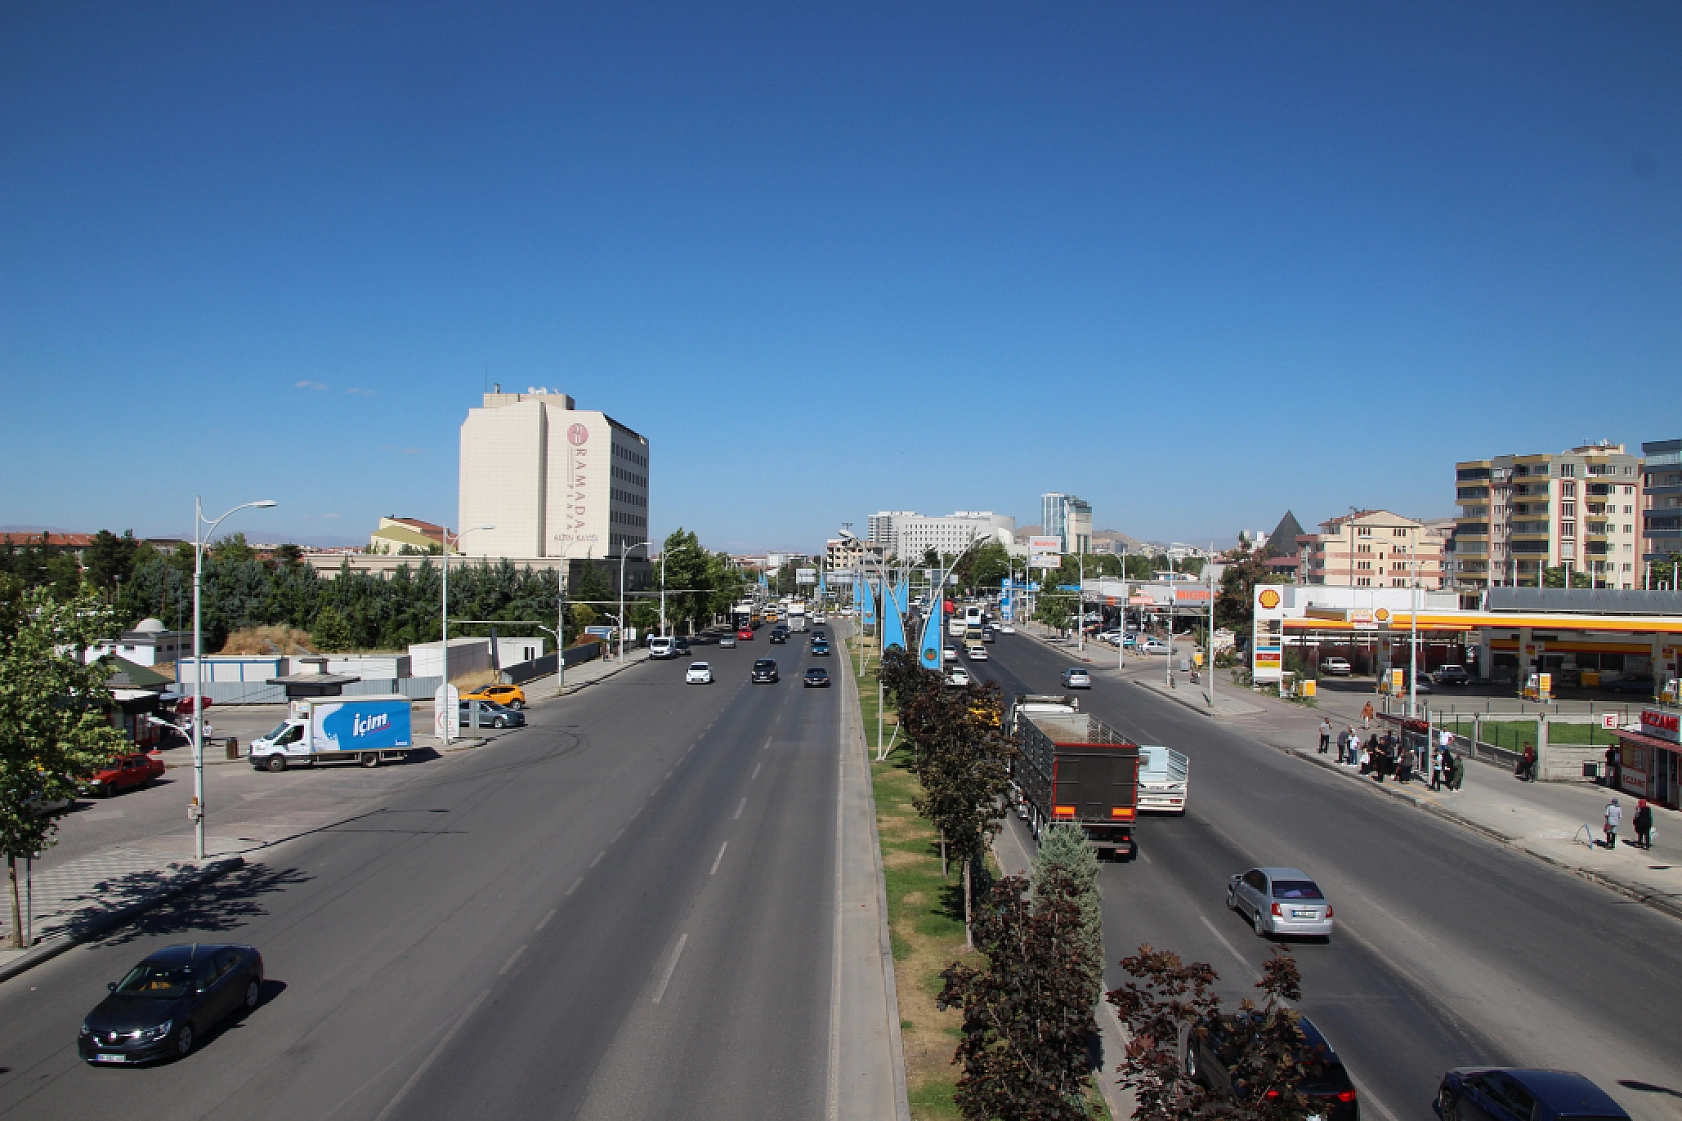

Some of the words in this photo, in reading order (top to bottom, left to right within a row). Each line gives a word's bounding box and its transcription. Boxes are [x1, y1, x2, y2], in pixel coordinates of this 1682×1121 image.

[574, 448, 587, 529] RAMADA
[352, 712, 389, 737] İçim
[1605, 716, 1614, 726] E
